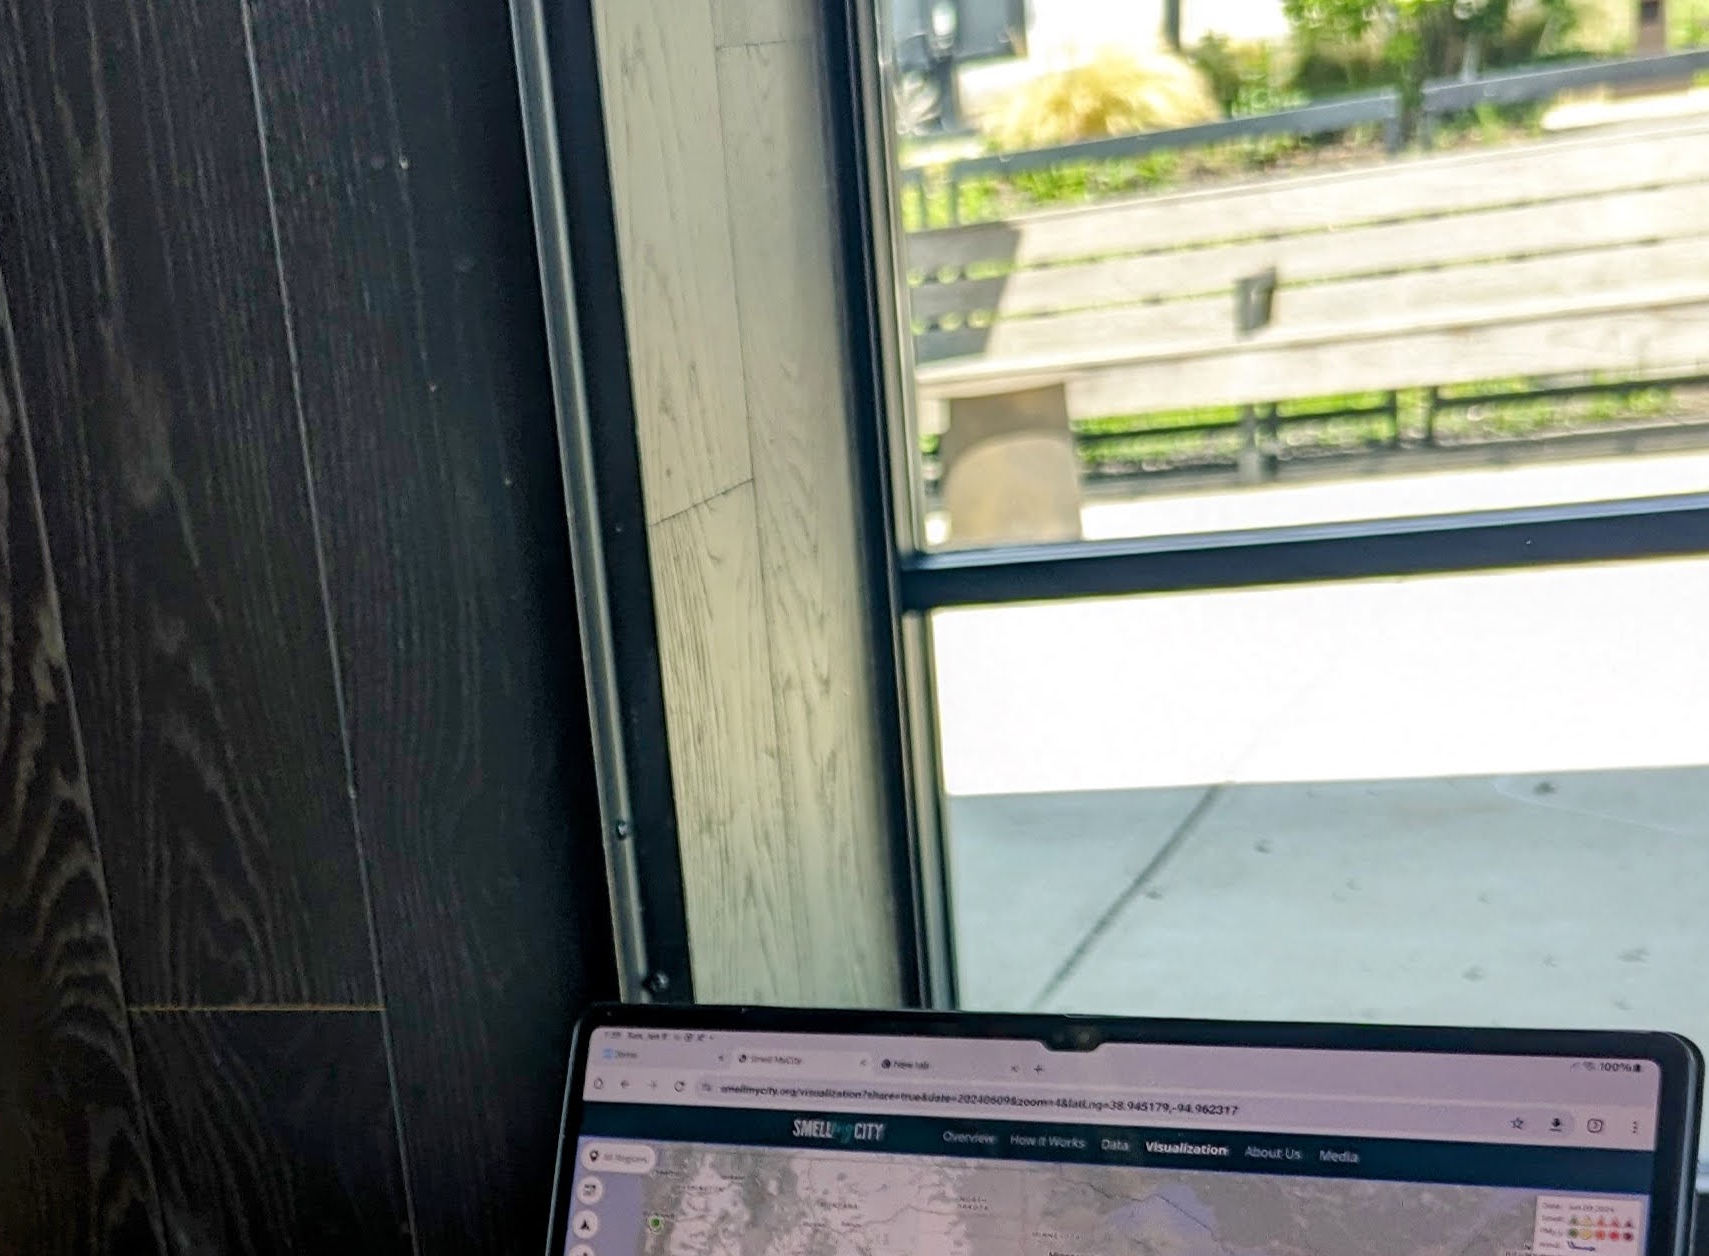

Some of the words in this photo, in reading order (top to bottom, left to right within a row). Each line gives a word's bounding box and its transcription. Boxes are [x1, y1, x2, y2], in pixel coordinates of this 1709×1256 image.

[1600, 1061, 1632, 1072] 100%
[942, 1130, 995, 1145] Overview
[1010, 1134, 1037, 1146] How
[1049, 1135, 1086, 1149] Works
[1101, 1138, 1130, 1151] Data
[1146, 1140, 1229, 1156] Visualization
[1244, 1145, 1284, 1160] About
[1285, 1147, 1302, 1160] Us
[1319, 1149, 1360, 1164] Media
